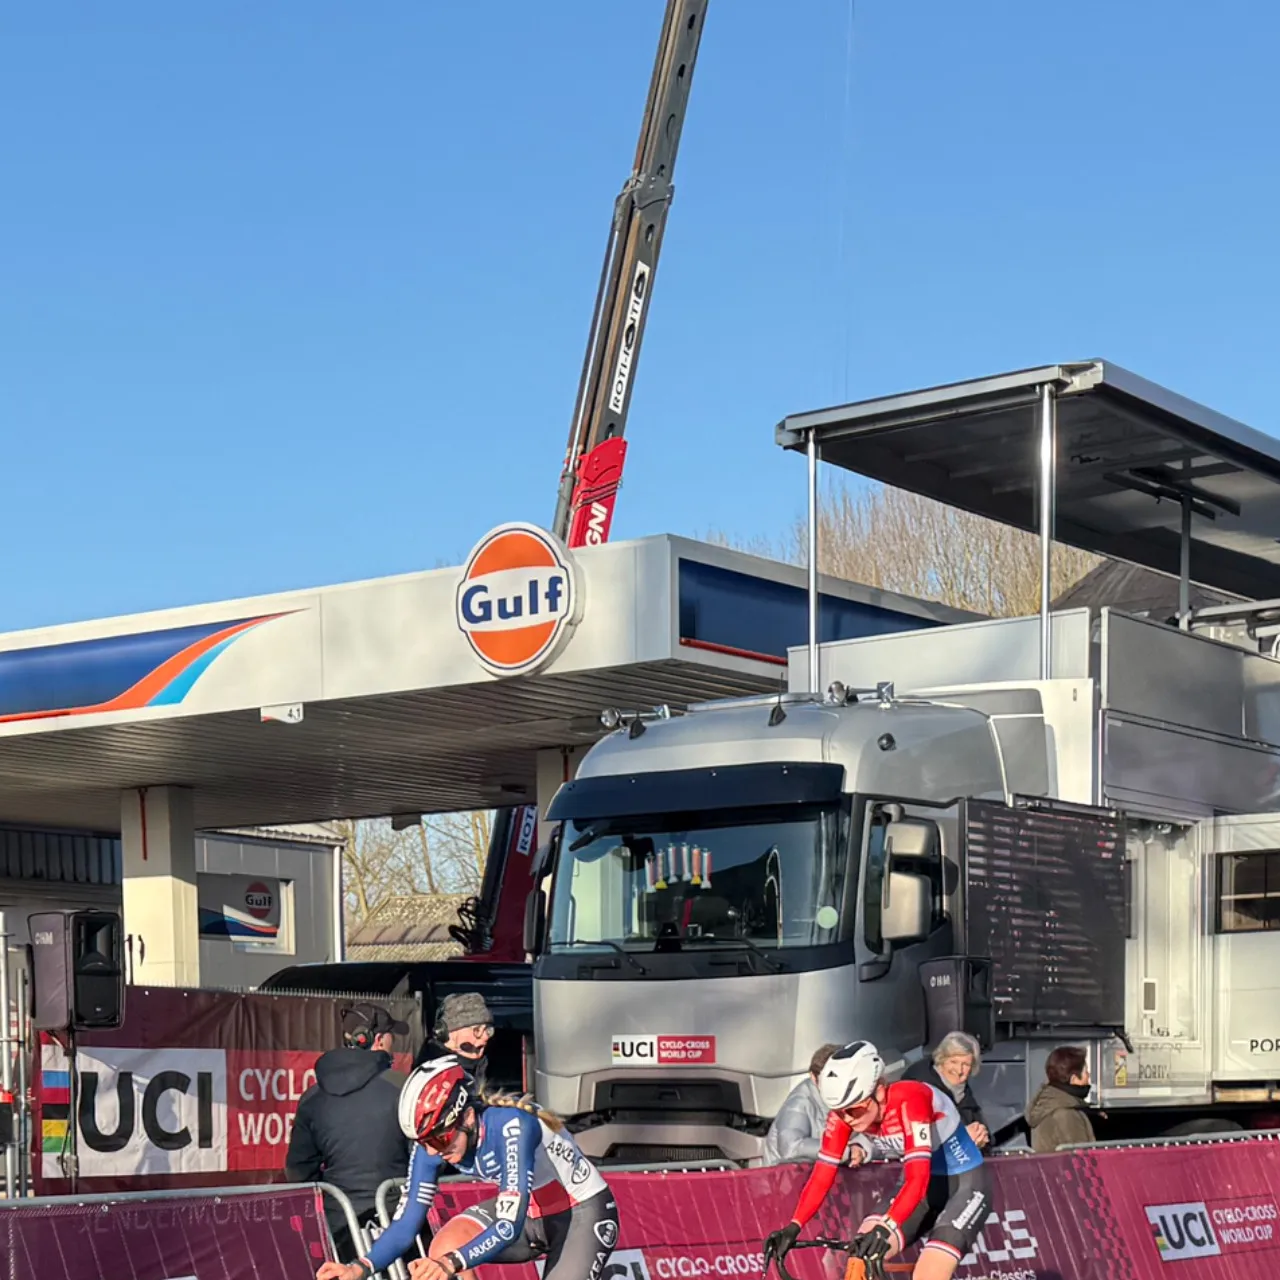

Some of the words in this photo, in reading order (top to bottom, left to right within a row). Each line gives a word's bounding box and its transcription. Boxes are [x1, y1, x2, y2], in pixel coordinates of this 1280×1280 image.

[461, 575, 564, 625] Gulf
[245, 894, 272, 906] Gulf
[621, 1041, 654, 1058] UCI
[78, 1070, 213, 1153] UCI
[919, 1128, 928, 1140] 6
[947, 1135, 971, 1165] FENIX
[1212, 1203, 1278, 1226] CYCLO-CROSS
[1158, 1210, 1217, 1251] UCI
[1219, 1227, 1254, 1245] WORLD
[1254, 1223, 1275, 1241] CUP
[468, 1234, 500, 1260] ARKEA
[655, 1252, 767, 1279] CYCLO-CROSS
